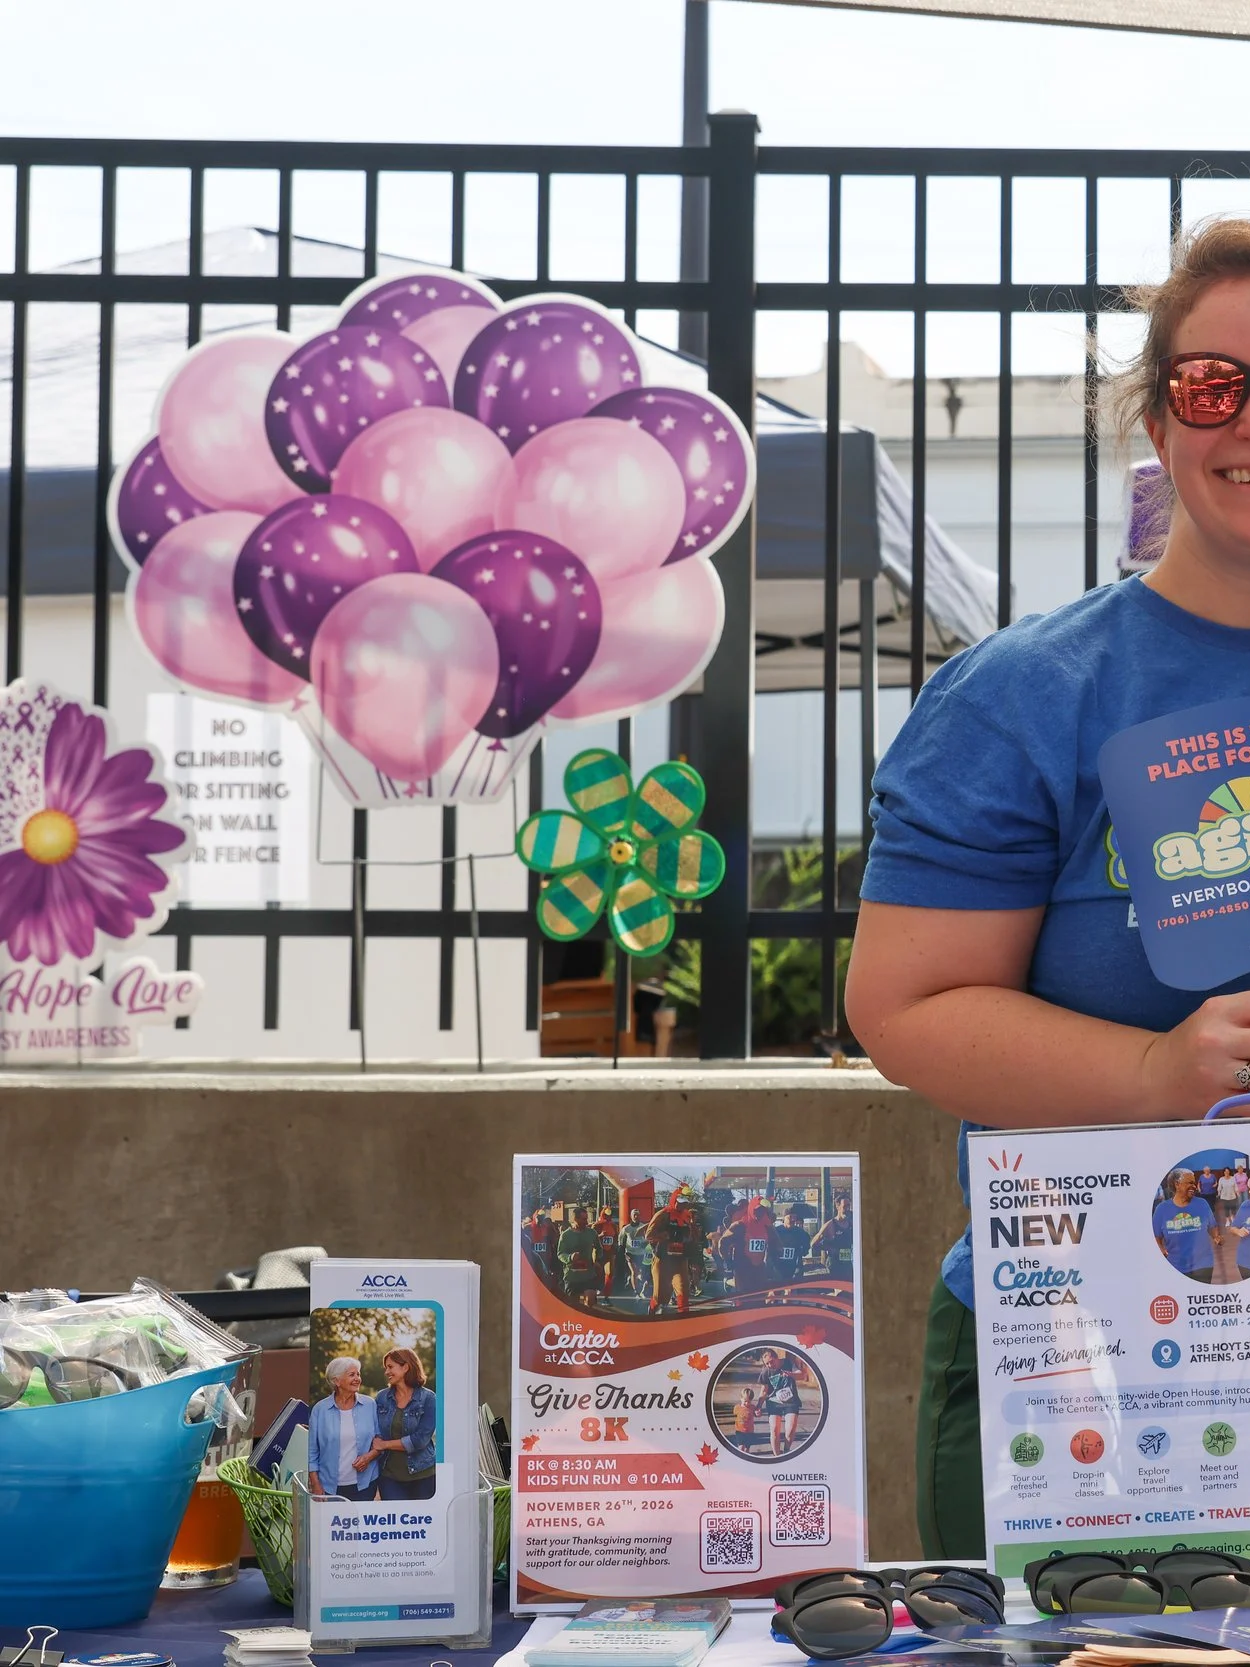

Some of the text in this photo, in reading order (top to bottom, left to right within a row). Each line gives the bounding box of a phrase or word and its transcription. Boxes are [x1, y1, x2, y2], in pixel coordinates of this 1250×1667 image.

[212, 718, 246, 737] NO
[1165, 732, 1219, 756] THIS
[1224, 727, 1246, 745] IS
[174, 751, 284, 769] CLIMBING
[1147, 752, 1220, 781] PLACE
[206, 782, 290, 800] SITTING
[220, 814, 278, 832] WALL
[215, 846, 282, 864] FENCE
[1157, 914, 1189, 930] (706)
[1192, 901, 1249, 920] 549-4850
[0, 965, 194, 1022] Hope Love
[27, 1026, 132, 1049] AWARENESS
[989, 1174, 1130, 1193] COME DISCOVER
[990, 1192, 1093, 1210] SOMETHING
[990, 1212, 1088, 1249] NEW
[1018, 1258, 1041, 1270] the
[361, 1275, 407, 1287] ACCA
[993, 1261, 1083, 1292] Center
[1000, 1289, 1078, 1308] at ACCA
[1186, 1293, 1241, 1304] TUESDAY,
[1188, 1304, 1242, 1316] OCTOBER
[562, 1321, 583, 1332] the
[1188, 1319, 1218, 1328] 11:00
[1221, 1318, 1238, 1327] AM
[539, 1324, 620, 1351] Center
[1190, 1343, 1209, 1352] 135
[1212, 1342, 1241, 1351] HOYT
[544, 1350, 614, 1367] at ACCA
[995, 1339, 1126, 1376] Aging Reimagined.
[1190, 1352, 1234, 1363] ATHENS,
[527, 1383, 695, 1418] Give Thanks
[580, 1416, 630, 1442] 8K
[527, 1458, 616, 1471] 8K @ 8:30 AM
[1138, 1466, 1170, 1477] Explore
[528, 1473, 682, 1485] KIDS FUN RUN @ 10 AM
[772, 1473, 827, 1481] VOLUNTEER:
[1143, 1475, 1165, 1484] travel
[1126, 1484, 1183, 1496] opportunities
[527, 1501, 600, 1512] NOVEMBER
[642, 1500, 673, 1510] 2026
[707, 1500, 752, 1508] REGISTER:
[330, 1513, 432, 1529] Age Well Care
[526, 1517, 605, 1528] ATHENS, GA
[1004, 1518, 1052, 1530] THRIVE
[1066, 1514, 1132, 1528] CONNECT
[1145, 1510, 1195, 1523] CREATE
[331, 1529, 426, 1543] Management
